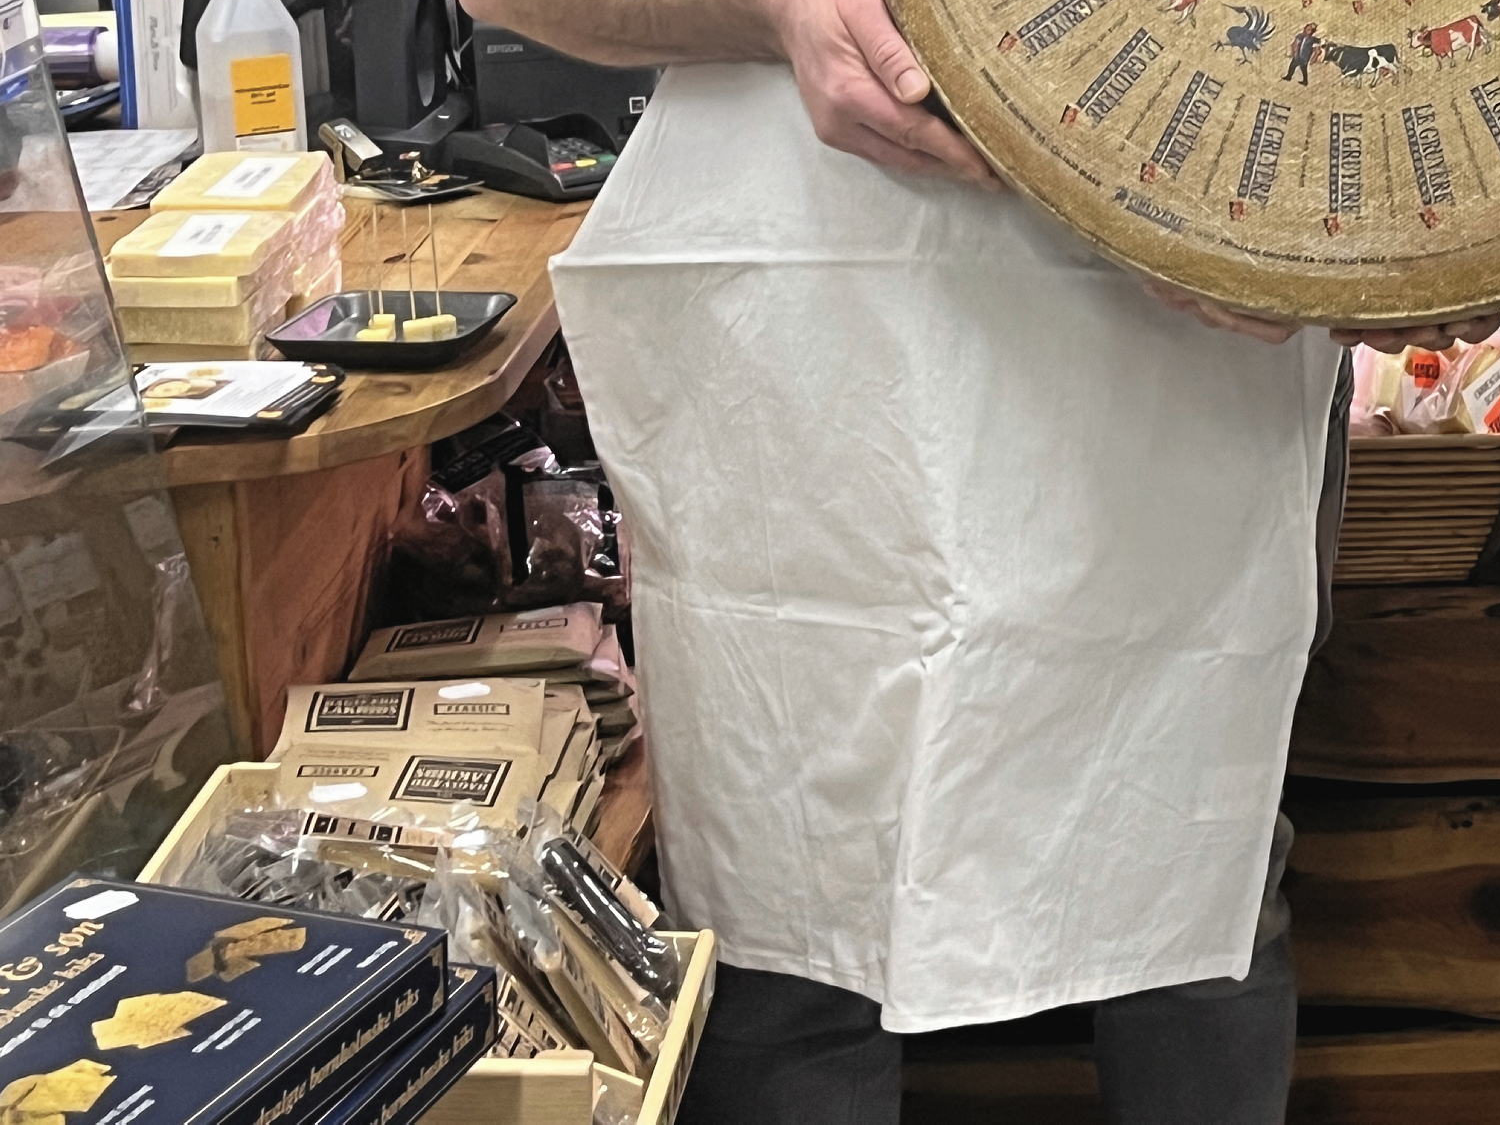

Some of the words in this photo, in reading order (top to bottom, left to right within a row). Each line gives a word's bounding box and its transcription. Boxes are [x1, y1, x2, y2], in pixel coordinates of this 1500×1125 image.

[1199, 76, 1227, 101] LE
[1270, 101, 1292, 125] LE
[1341, 113, 1363, 133] LE
[44, 921, 104, 957] søn
